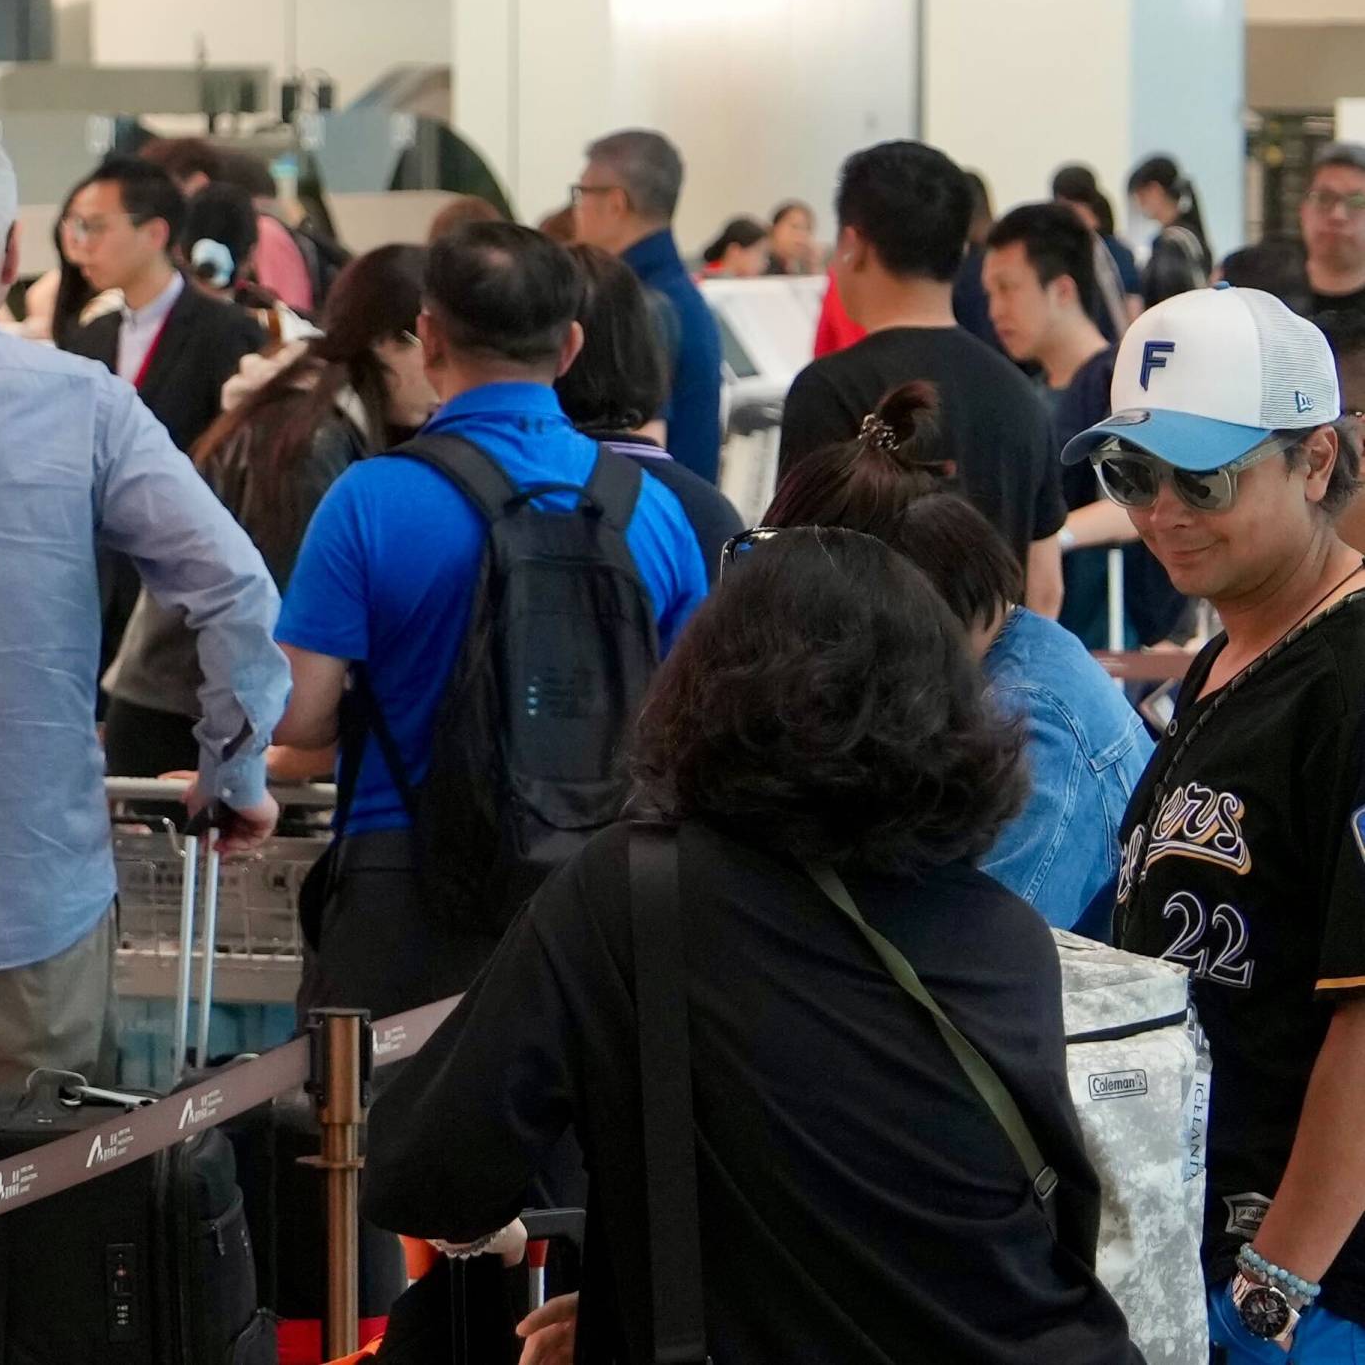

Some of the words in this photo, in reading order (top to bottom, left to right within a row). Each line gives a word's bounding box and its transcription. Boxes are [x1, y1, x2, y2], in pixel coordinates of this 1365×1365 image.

[1139, 340, 1176, 392] F
[1159, 890, 1254, 988] 22
[1092, 1077, 1136, 1094] Coleman
[1182, 1081, 1206, 1183] ICELAND
